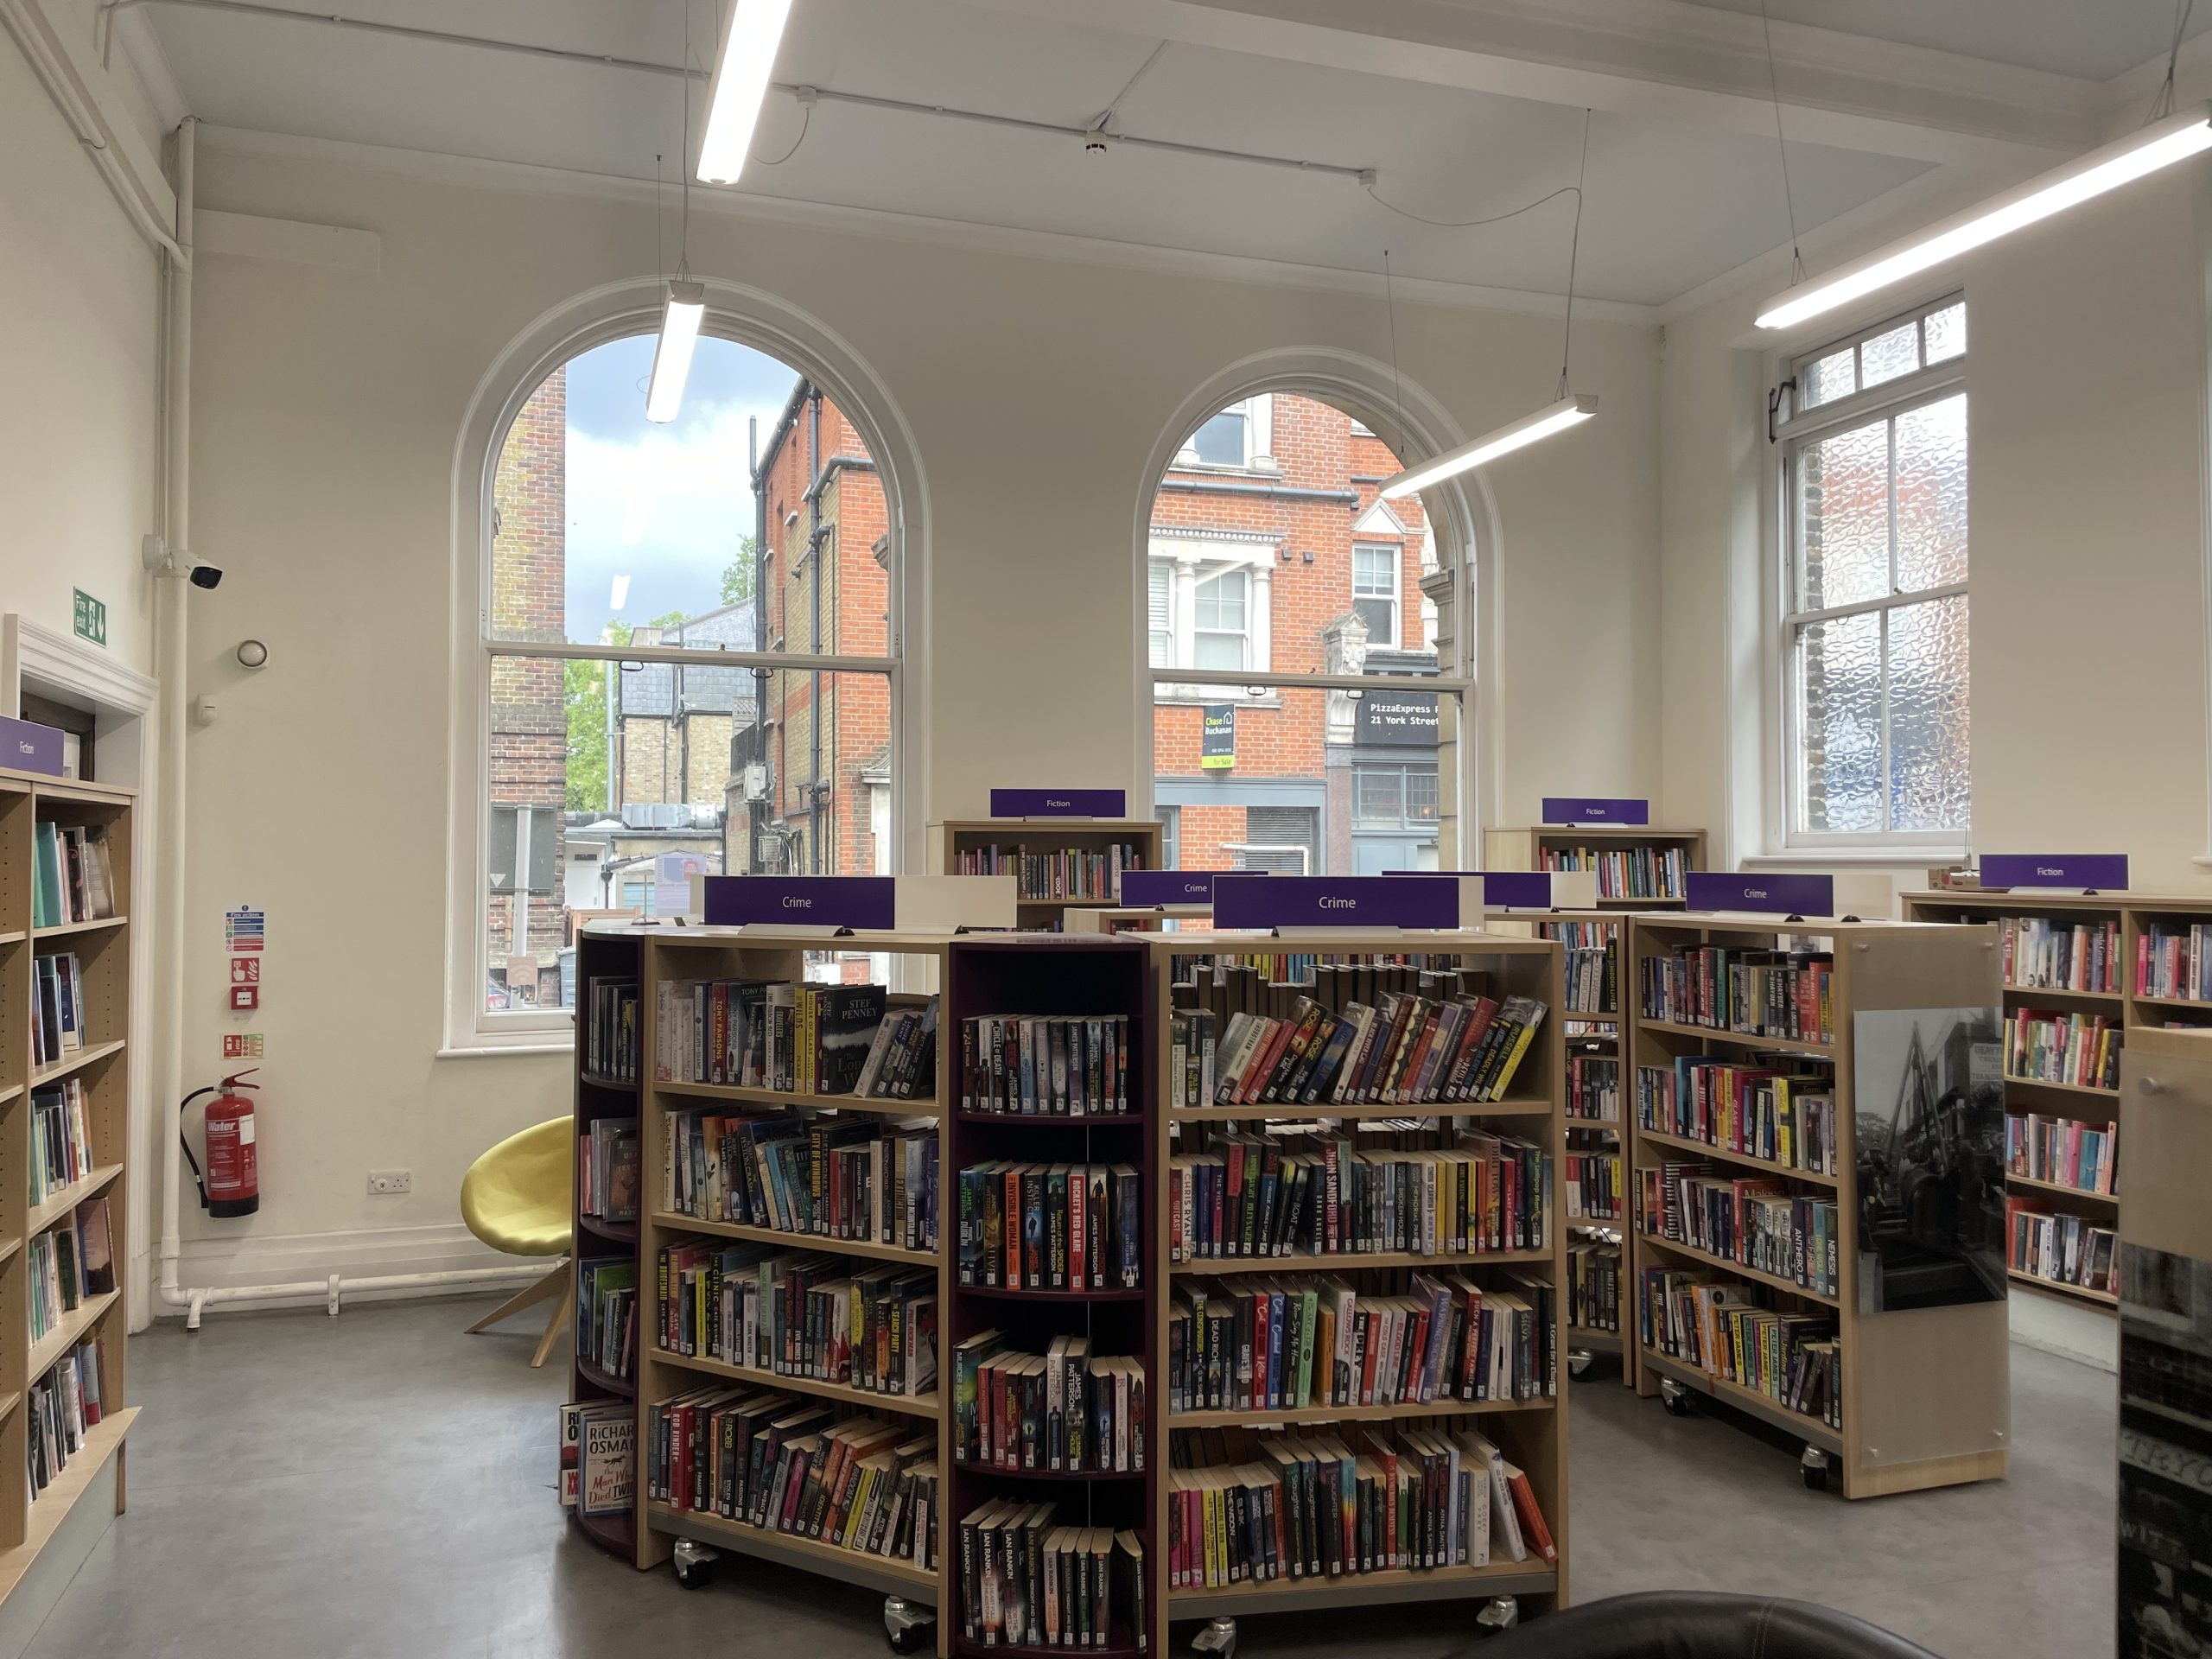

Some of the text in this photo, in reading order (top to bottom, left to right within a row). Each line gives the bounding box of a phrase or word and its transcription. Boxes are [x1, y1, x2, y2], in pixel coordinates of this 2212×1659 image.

[76, 595, 86, 613] Fire
[76, 615, 86, 629] exit
[1370, 703, 1431, 714] PizzaExpress
[1206, 717, 1223, 726] Chase
[1410, 716, 1439, 725] Street
[20, 741, 34, 753] Fiction
[783, 897, 811, 907] Crime
[1319, 897, 1356, 908] Crime
[1745, 889, 1767, 898] Crime
[849, 999, 872, 1008] STEF
[809, 1019, 813, 1030] OF
[842, 1009, 877, 1020] PENNEY
[1302, 1007, 1321, 1033] ROSE
[1306, 1036, 1322, 1060] ROSE
[207, 1121, 235, 1132] Water
[812, 1133, 821, 1198] CITY OF WINDOWS
[745, 1166, 754, 1192] CRASH
[1326, 1148, 1338, 1223] JOHN SANDFORD
[1007, 1182, 1016, 1219] INVISIBLE
[1291, 1202, 1300, 1224] BOAT
[1795, 1228, 1803, 1272] ANTIHERO
[1827, 1239, 1836, 1275] NEMESIS
[659, 1266, 668, 1300] BRIDESMAID
[1344, 1298, 1353, 1333] GALLOWS
[1428, 1297, 1449, 1370] WARNING SIGNS
[1470, 1329, 1478, 1357] PERFECT
[590, 1424, 633, 1440] RiCHAR
[593, 1476, 613, 1491] Man
[588, 1487, 612, 1504] Died
[760, 1489, 768, 1512] PAYBACK
[1291, 1474, 1300, 1519] Slaughter
[813, 1494, 825, 1526] IDENTITY
